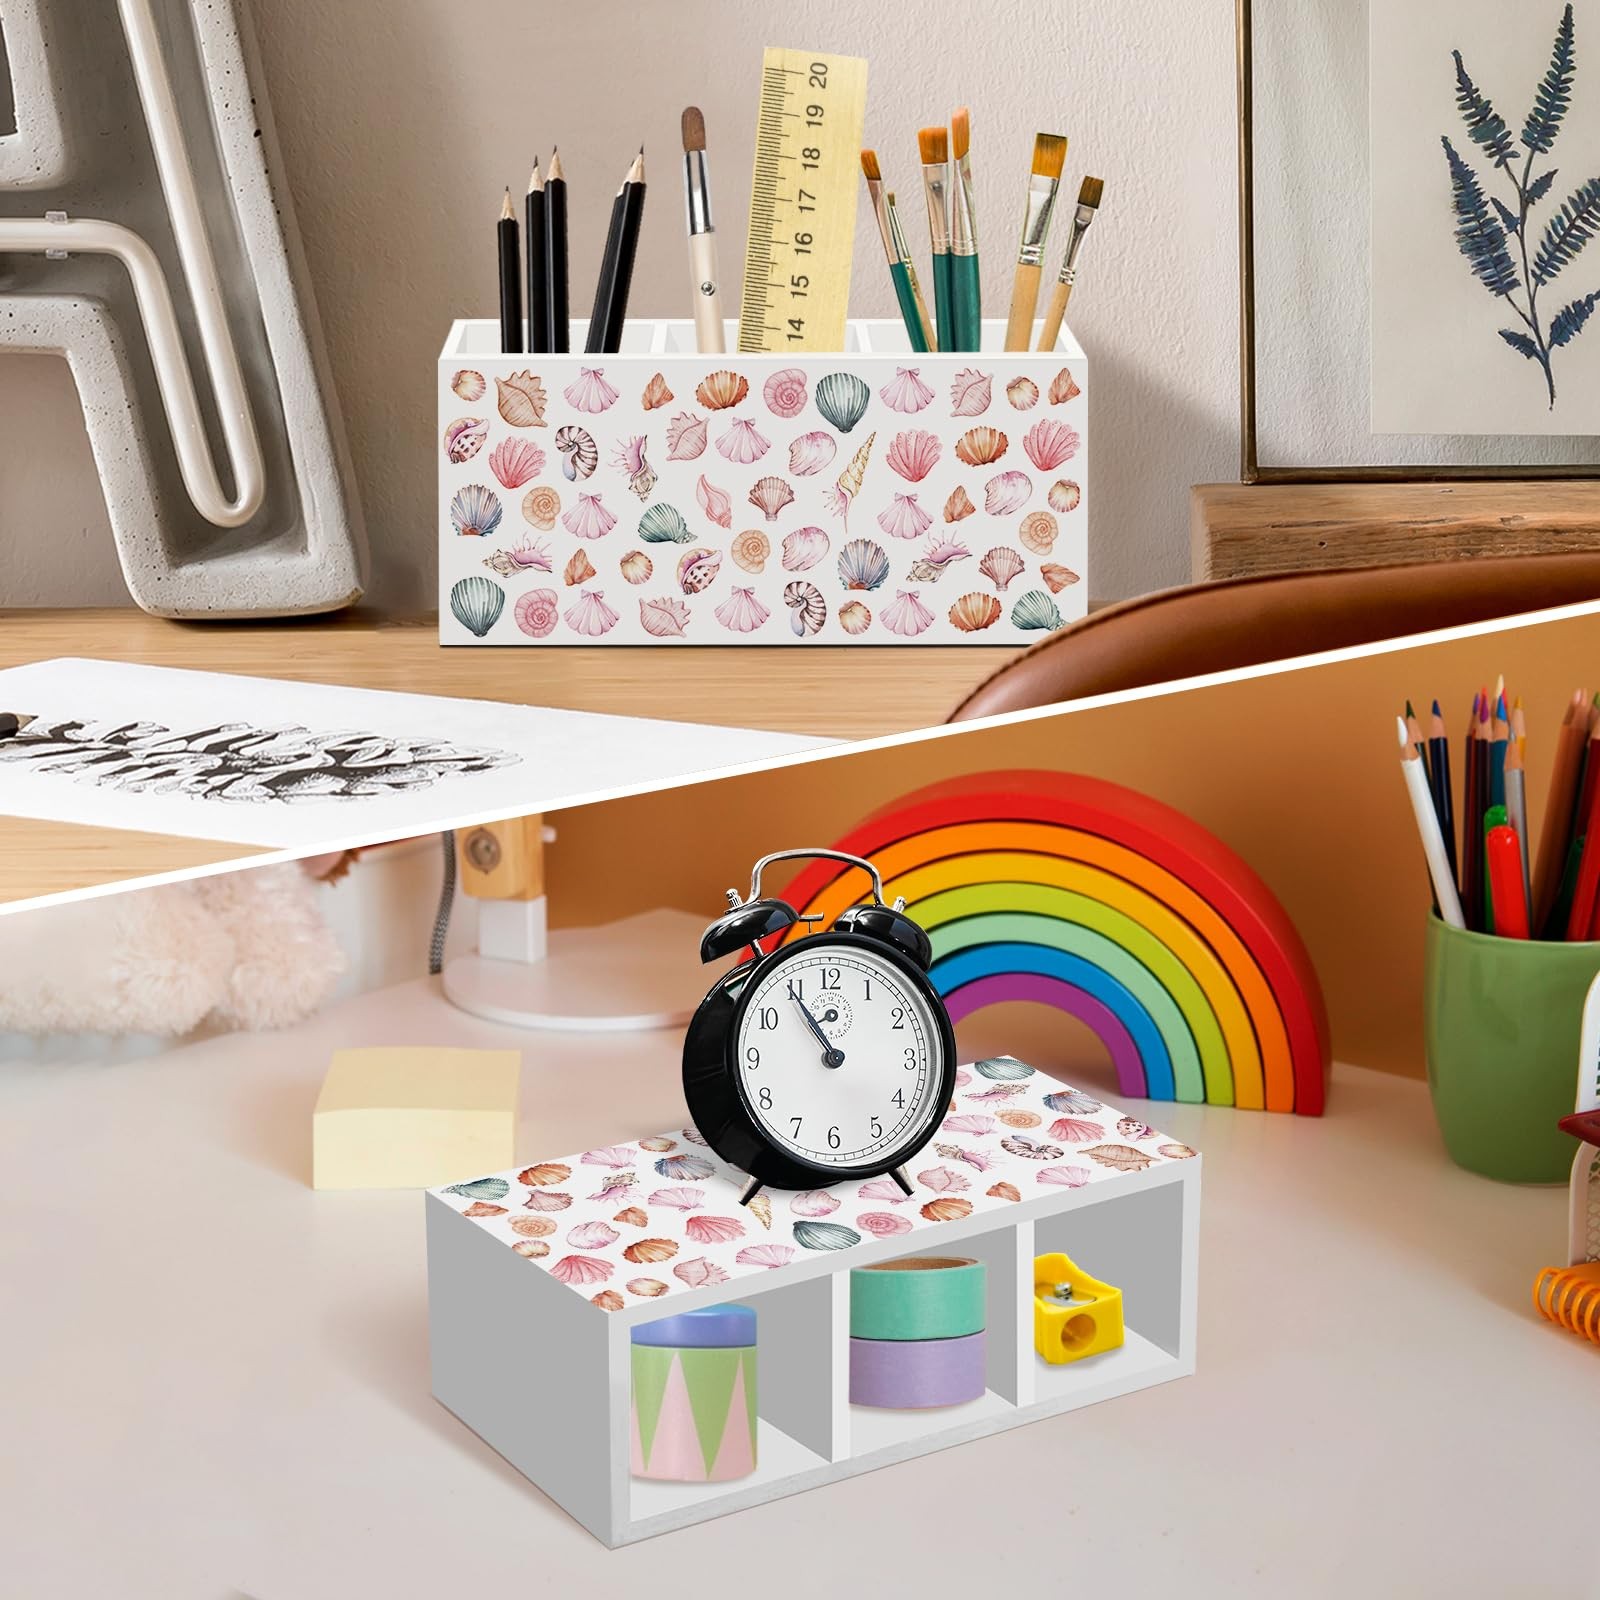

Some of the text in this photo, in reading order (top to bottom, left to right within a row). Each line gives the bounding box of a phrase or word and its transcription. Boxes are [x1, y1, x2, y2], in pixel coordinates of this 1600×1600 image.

[808, 62, 828, 89] 20
[805, 104, 824, 128] 19
[801, 147, 820, 171] 18
[798, 188, 816, 213] 17
[794, 232, 813, 256] 16
[790, 274, 809, 299] 15
[786, 318, 805, 342] 14
[786, 978, 805, 1001] 11
[819, 968, 841, 990] 12
[863, 979, 873, 1001] 1
[757, 1007, 779, 1030] 10
[891, 1007, 904, 1030] 2
[746, 1047, 760, 1070] 9
[903, 1048, 917, 1070] 3
[758, 1087, 773, 1110] 8
[890, 1088, 905, 1109] 4
[789, 1117, 803, 1139] 7
[827, 1125, 841, 1149] 6
[870, 1115, 883, 1139] 5
